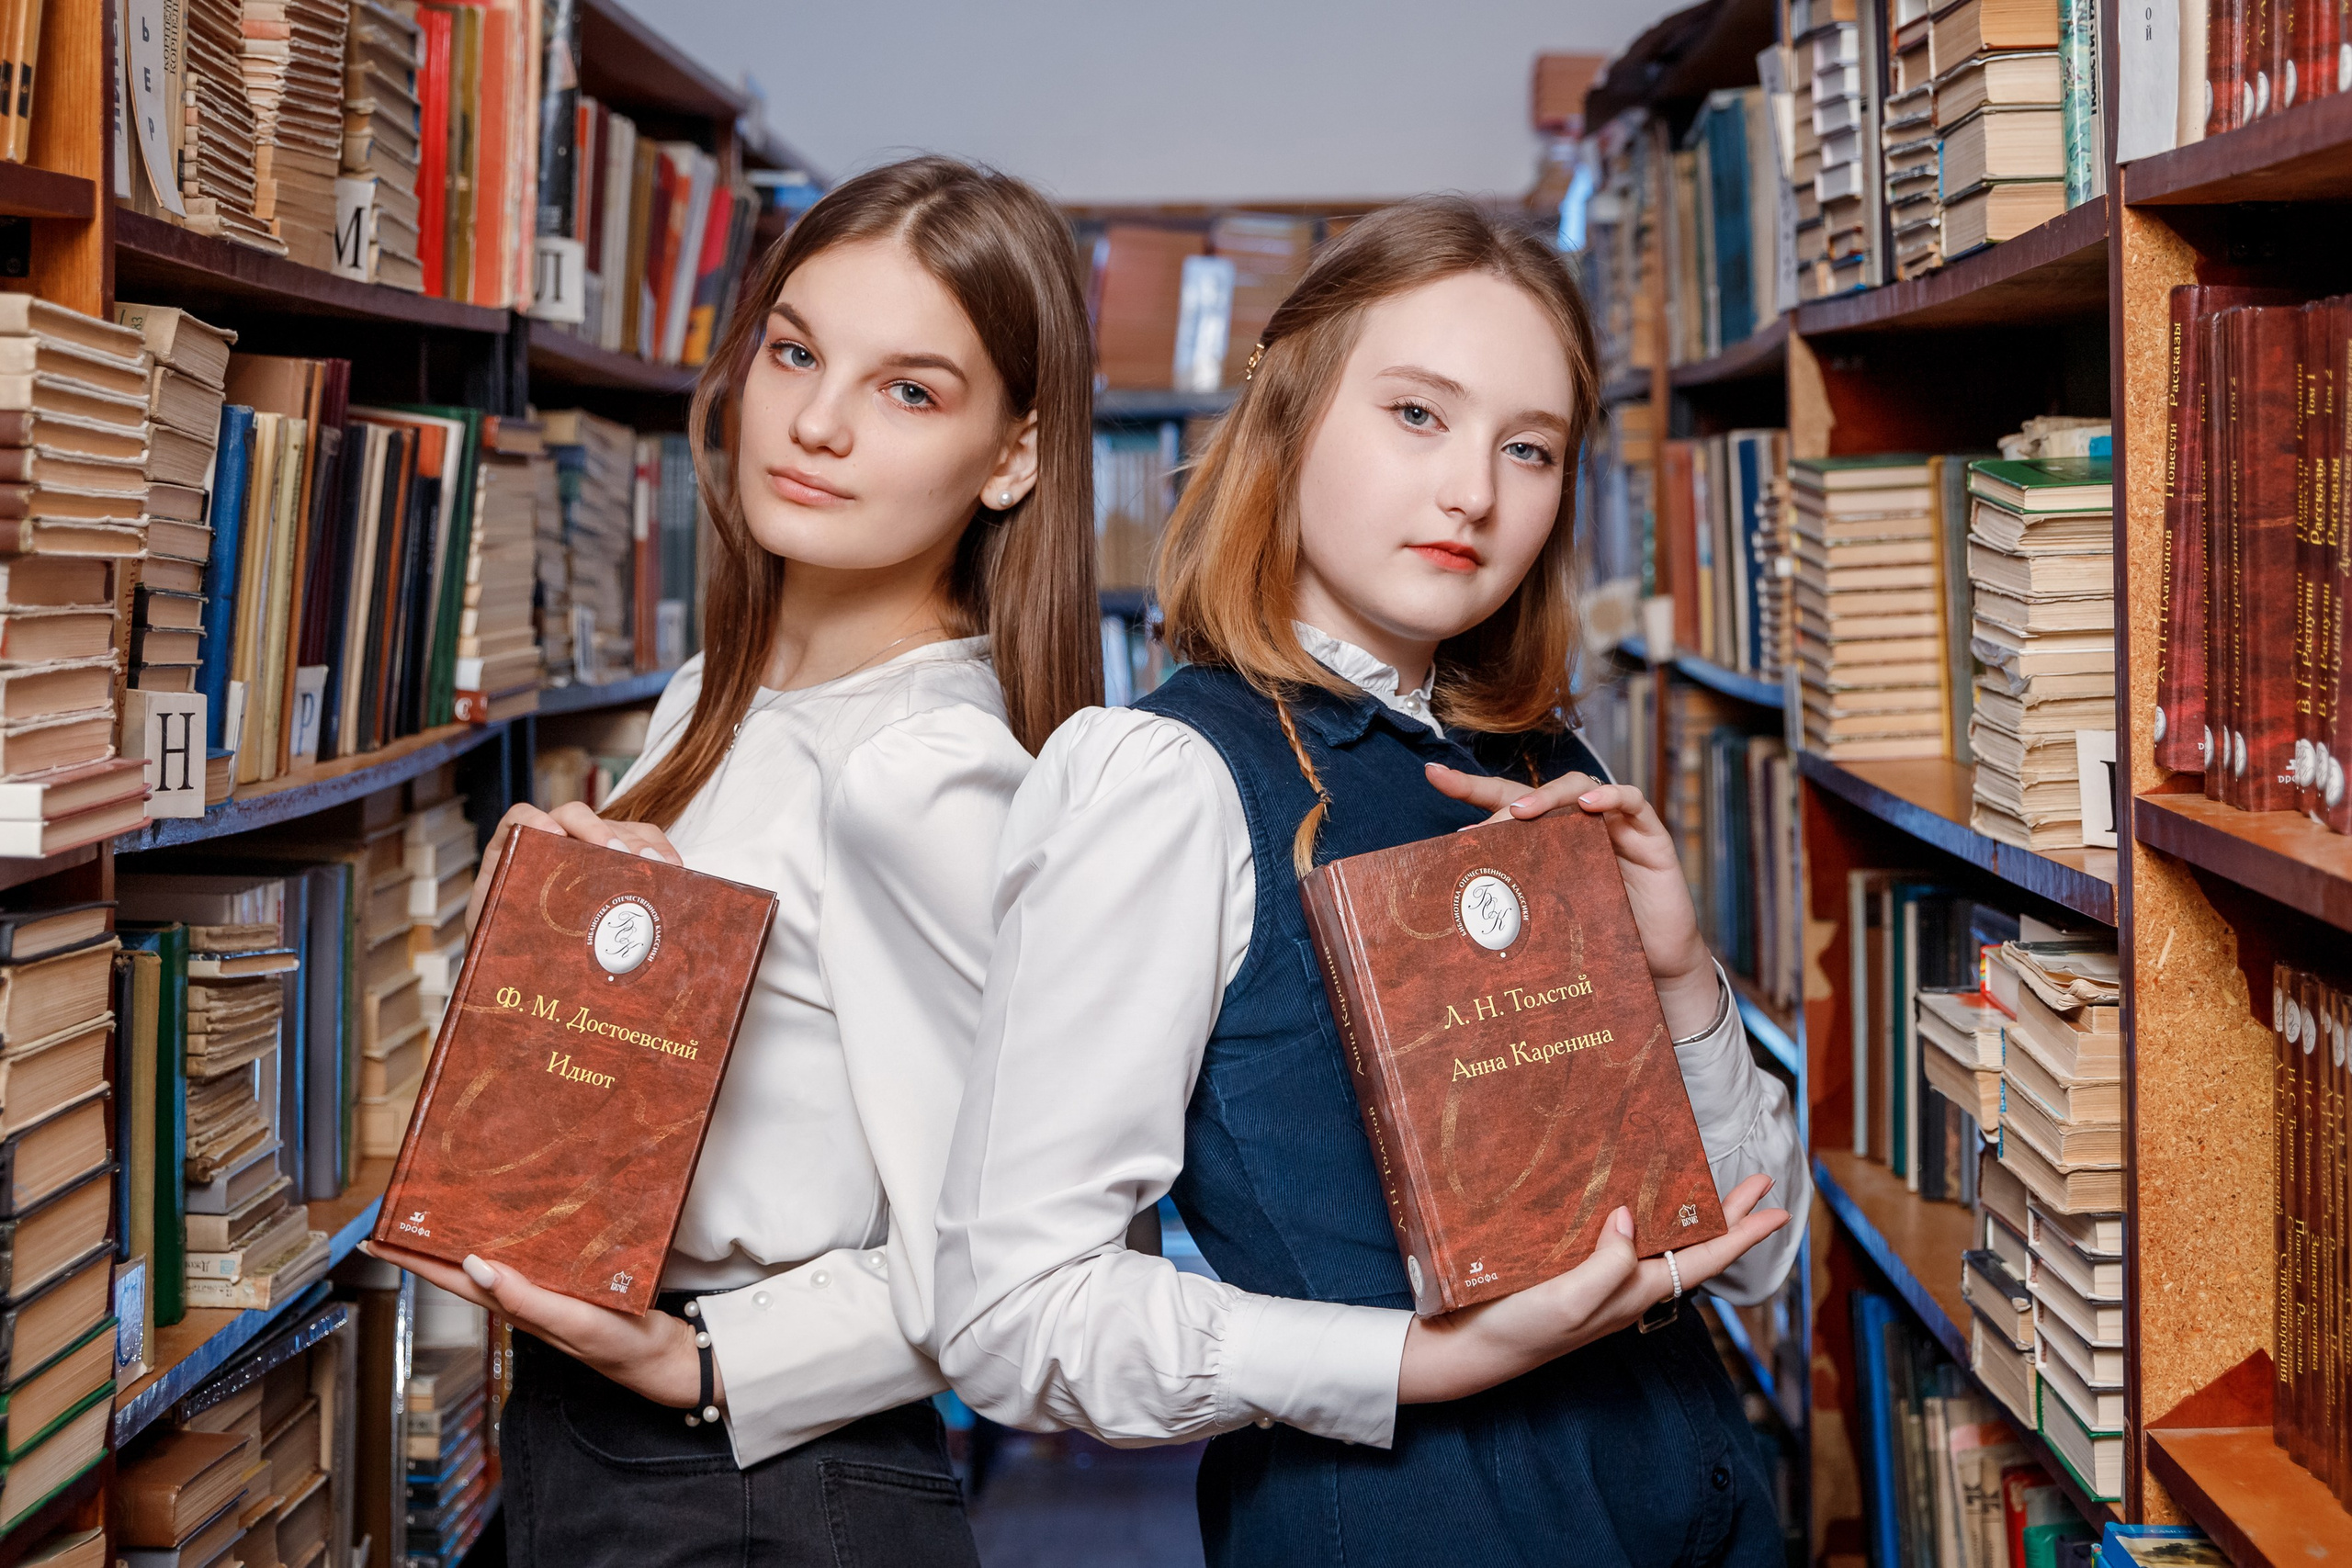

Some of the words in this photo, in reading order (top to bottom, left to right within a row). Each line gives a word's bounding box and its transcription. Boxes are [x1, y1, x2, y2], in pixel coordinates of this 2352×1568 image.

[2169, 321, 2182, 408] Рассказы
[2324, 369, 2333, 380] 2
[2306, 387, 2315, 419] Том
[2324, 386, 2333, 415] Том
[2165, 423, 2177, 499] Повести
[2310, 457, 2324, 546] Рассказы
[2327, 457, 2340, 547] Рассказы
[2336, 455, 2352, 577] Драматические
[2159, 529, 2172, 624] Платонов
[2301, 581, 2315, 668] Распутин
[2319, 581, 2331, 671] Распутин
[2301, 674, 2312, 689] Г.
[2301, 695, 2312, 715] В.
[154, 712, 196, 792] Н
[1458, 867, 1511, 888] ОТЕЧЕСТВЕННОЙ
[1511, 883, 1530, 921] КЛАССИКИ
[586, 904, 611, 946] БИБЛИОТЕКА
[611, 895, 661, 922] ОТЕЧЕСТВЕННОЙ
[647, 924, 662, 963] КЛАССИКИ
[1453, 890, 1467, 937] БИБЛИОТЕКА
[1324, 945, 1351, 1028] Каренина
[1444, 1004, 1471, 1030] Л.
[1474, 995, 1505, 1021] Н.
[1504, 974, 1593, 1012] Толстой
[496, 986, 524, 1012] Ф.
[531, 994, 560, 1022] М.
[566, 1006, 699, 1060] Достоевский
[1347, 1030, 1364, 1076] Анна
[1452, 1057, 1509, 1082] Анна
[1510, 1028, 1614, 1066] Каренина
[546, 1051, 616, 1089] Идиот
[1369, 1105, 1392, 1180] Толстой
[2275, 1107, 2285, 1215] Твардовский
[2287, 1115, 2297, 1182] Тургенев
[2304, 1128, 2312, 1196] Тургенев
[2295, 1219, 2305, 1284] Повести
[2311, 1232, 2321, 1299] Записки
[2278, 1253, 2289, 1383] Стихотворения
[2296, 1302, 2307, 1375] Рассказы
[2311, 1303, 2320, 1371] охотника
